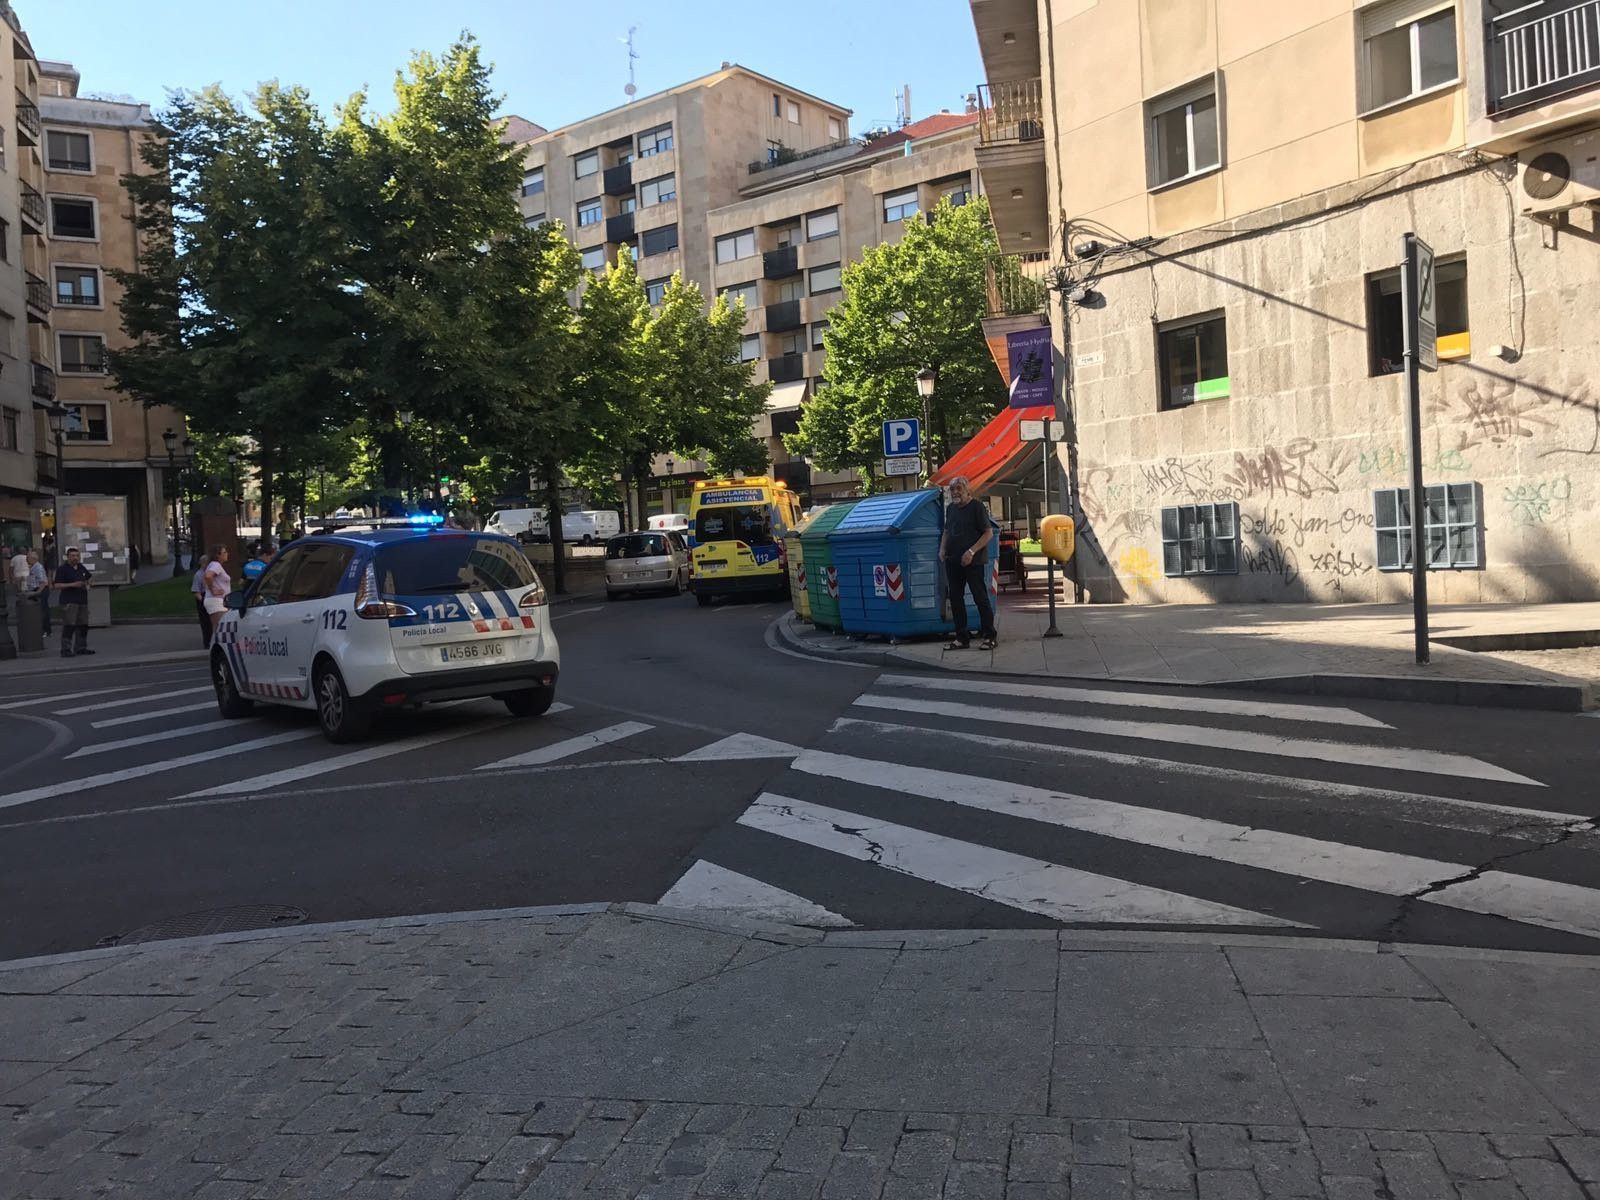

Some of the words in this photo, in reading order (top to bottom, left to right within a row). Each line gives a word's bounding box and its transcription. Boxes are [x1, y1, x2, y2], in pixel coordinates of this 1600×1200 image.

[889, 421, 913, 452] P
[705, 489, 758, 499] AMBULANCIA
[705, 495, 758, 504] ASISTENCIAL
[756, 553, 769, 563] 112
[423, 603, 460, 619] 112
[322, 609, 347, 630] 112
[428, 626, 447, 635] Local
[268, 636, 289, 656] Local
[449, 646, 479, 659] 4566
[482, 644, 503, 656] JVG
